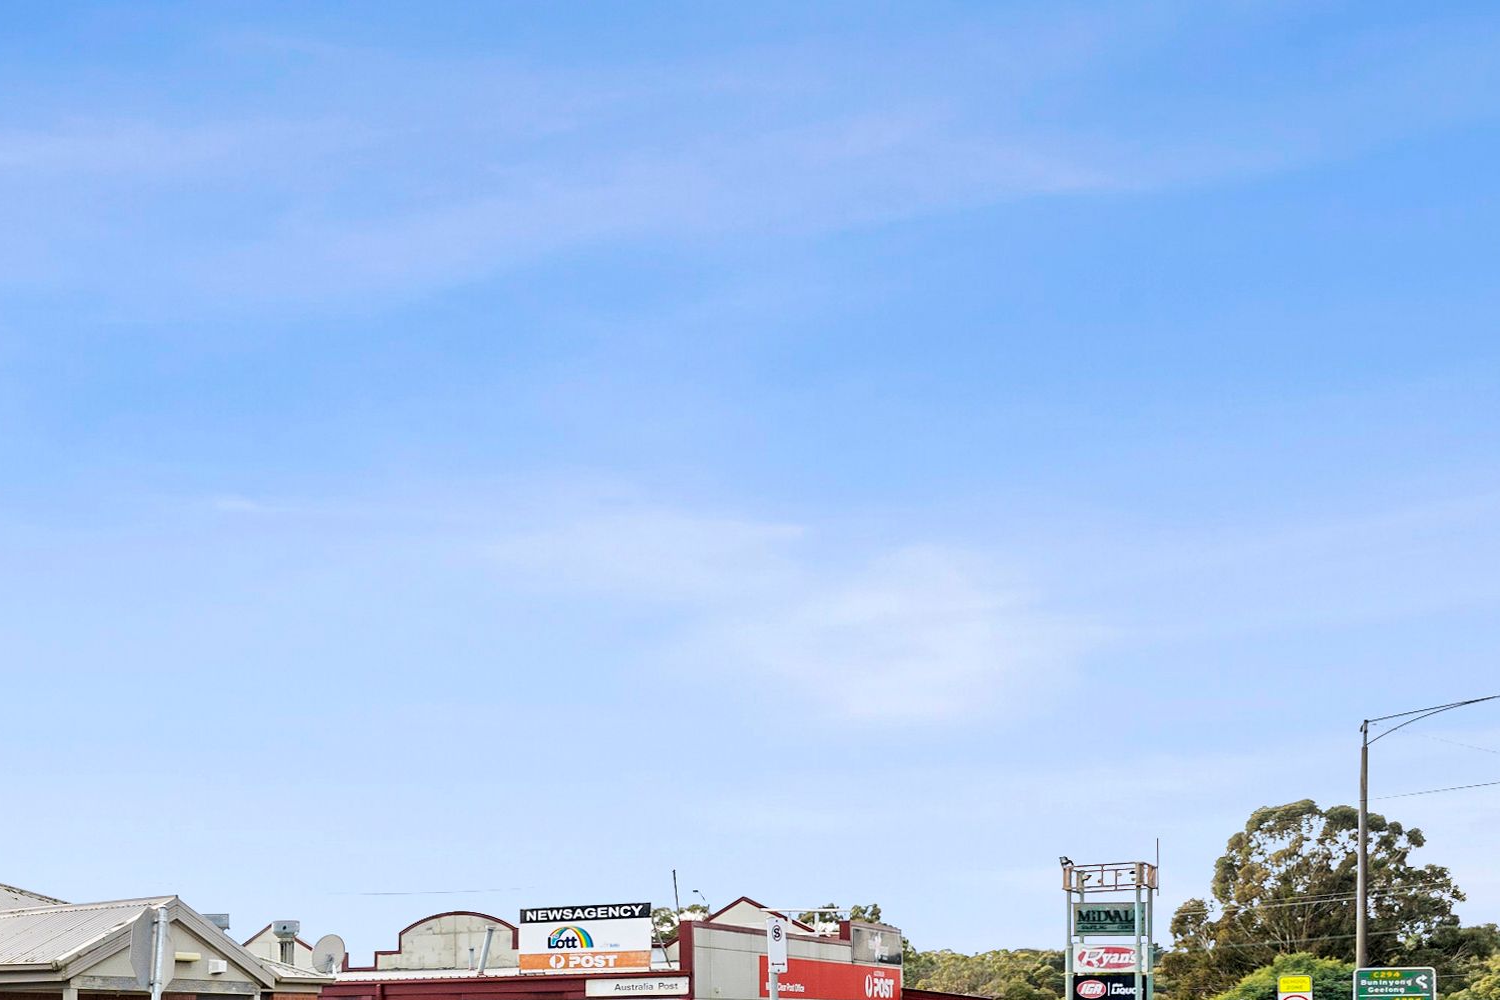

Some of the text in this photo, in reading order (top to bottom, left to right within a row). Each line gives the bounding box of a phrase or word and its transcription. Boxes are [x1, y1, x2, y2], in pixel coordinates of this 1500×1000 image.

[526, 905, 643, 921] NEWSAGENCY
[547, 936, 577, 949] Lott
[569, 954, 618, 968] POST
[614, 981, 679, 991] Australia Post
[873, 977, 895, 998] POST
[1080, 983, 1102, 995] IGA
[1360, 979, 1412, 987] Buninyong
[1368, 986, 1405, 994] Geelong
